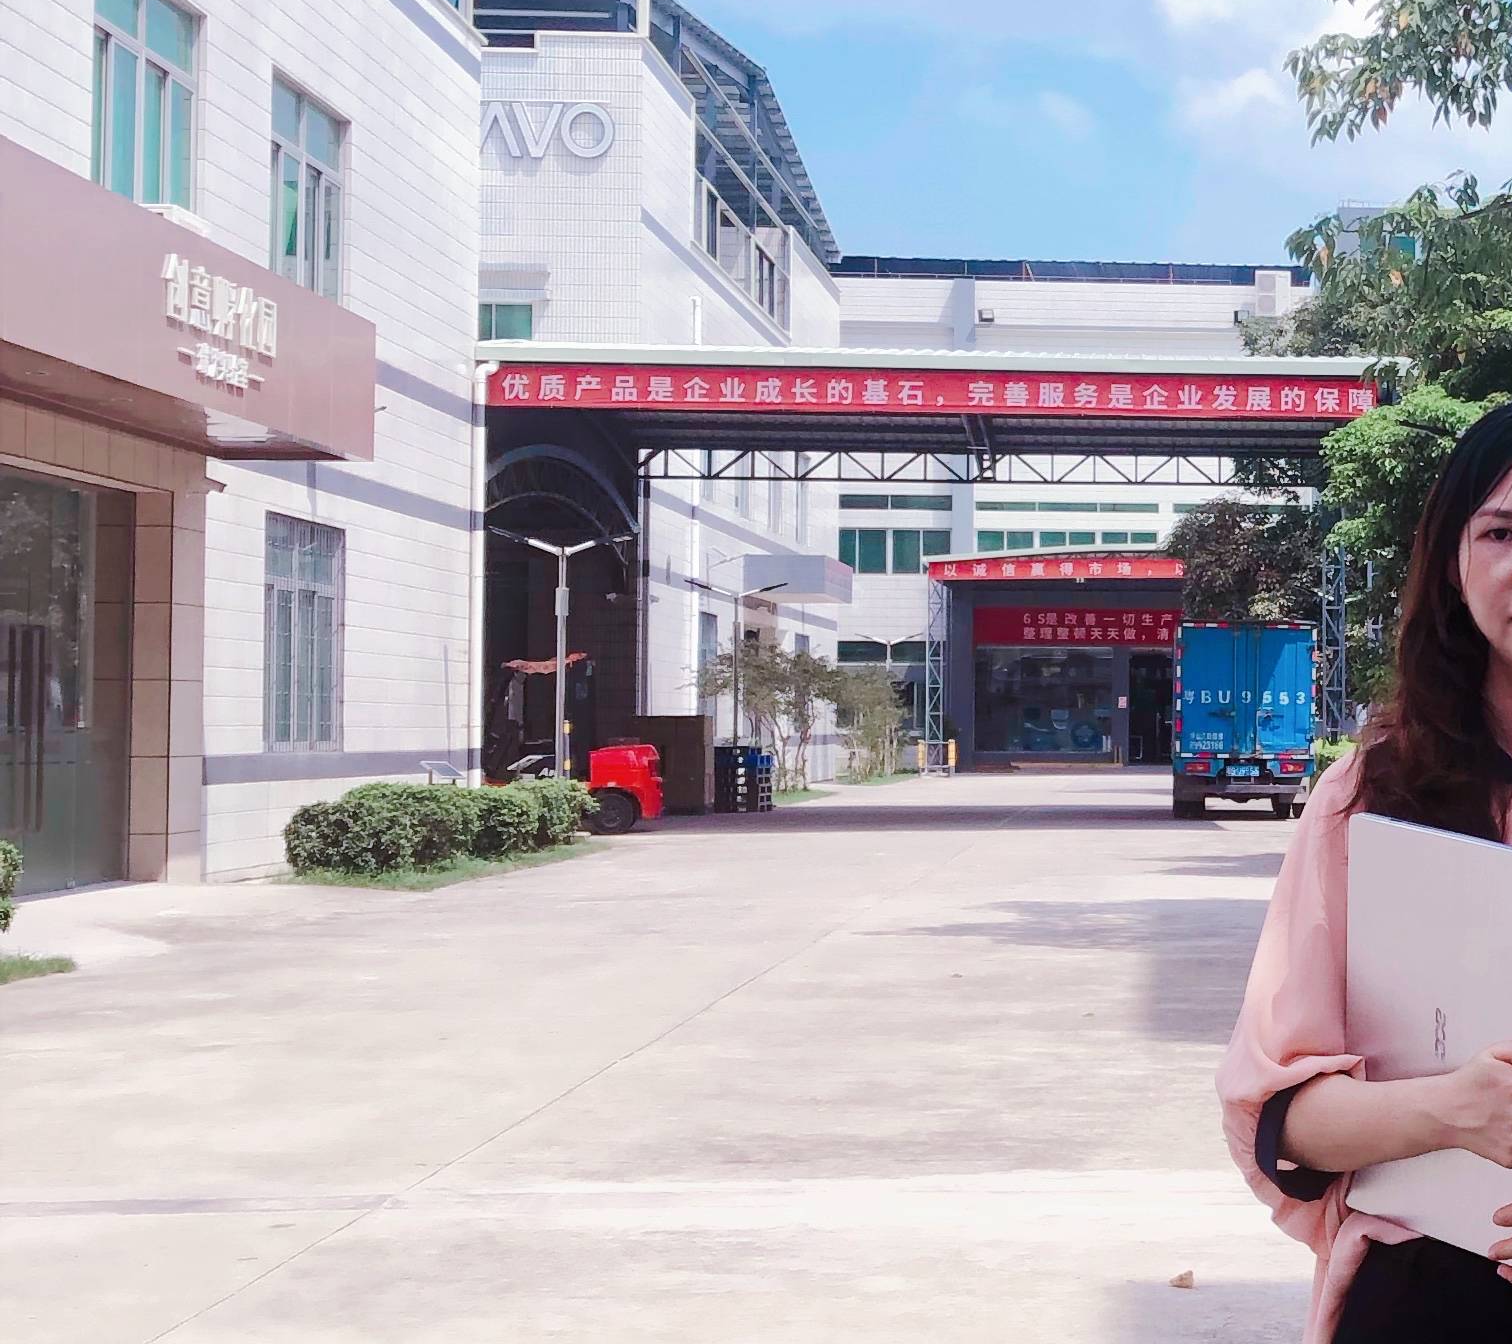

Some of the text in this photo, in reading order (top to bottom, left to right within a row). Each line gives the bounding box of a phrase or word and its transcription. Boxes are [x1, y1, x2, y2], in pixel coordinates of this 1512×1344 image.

[502, 373, 1374, 413] 优质产品是企业成长的基石，完善服务是企业发展的保障
[1434, 1007, 1446, 1061] ace
